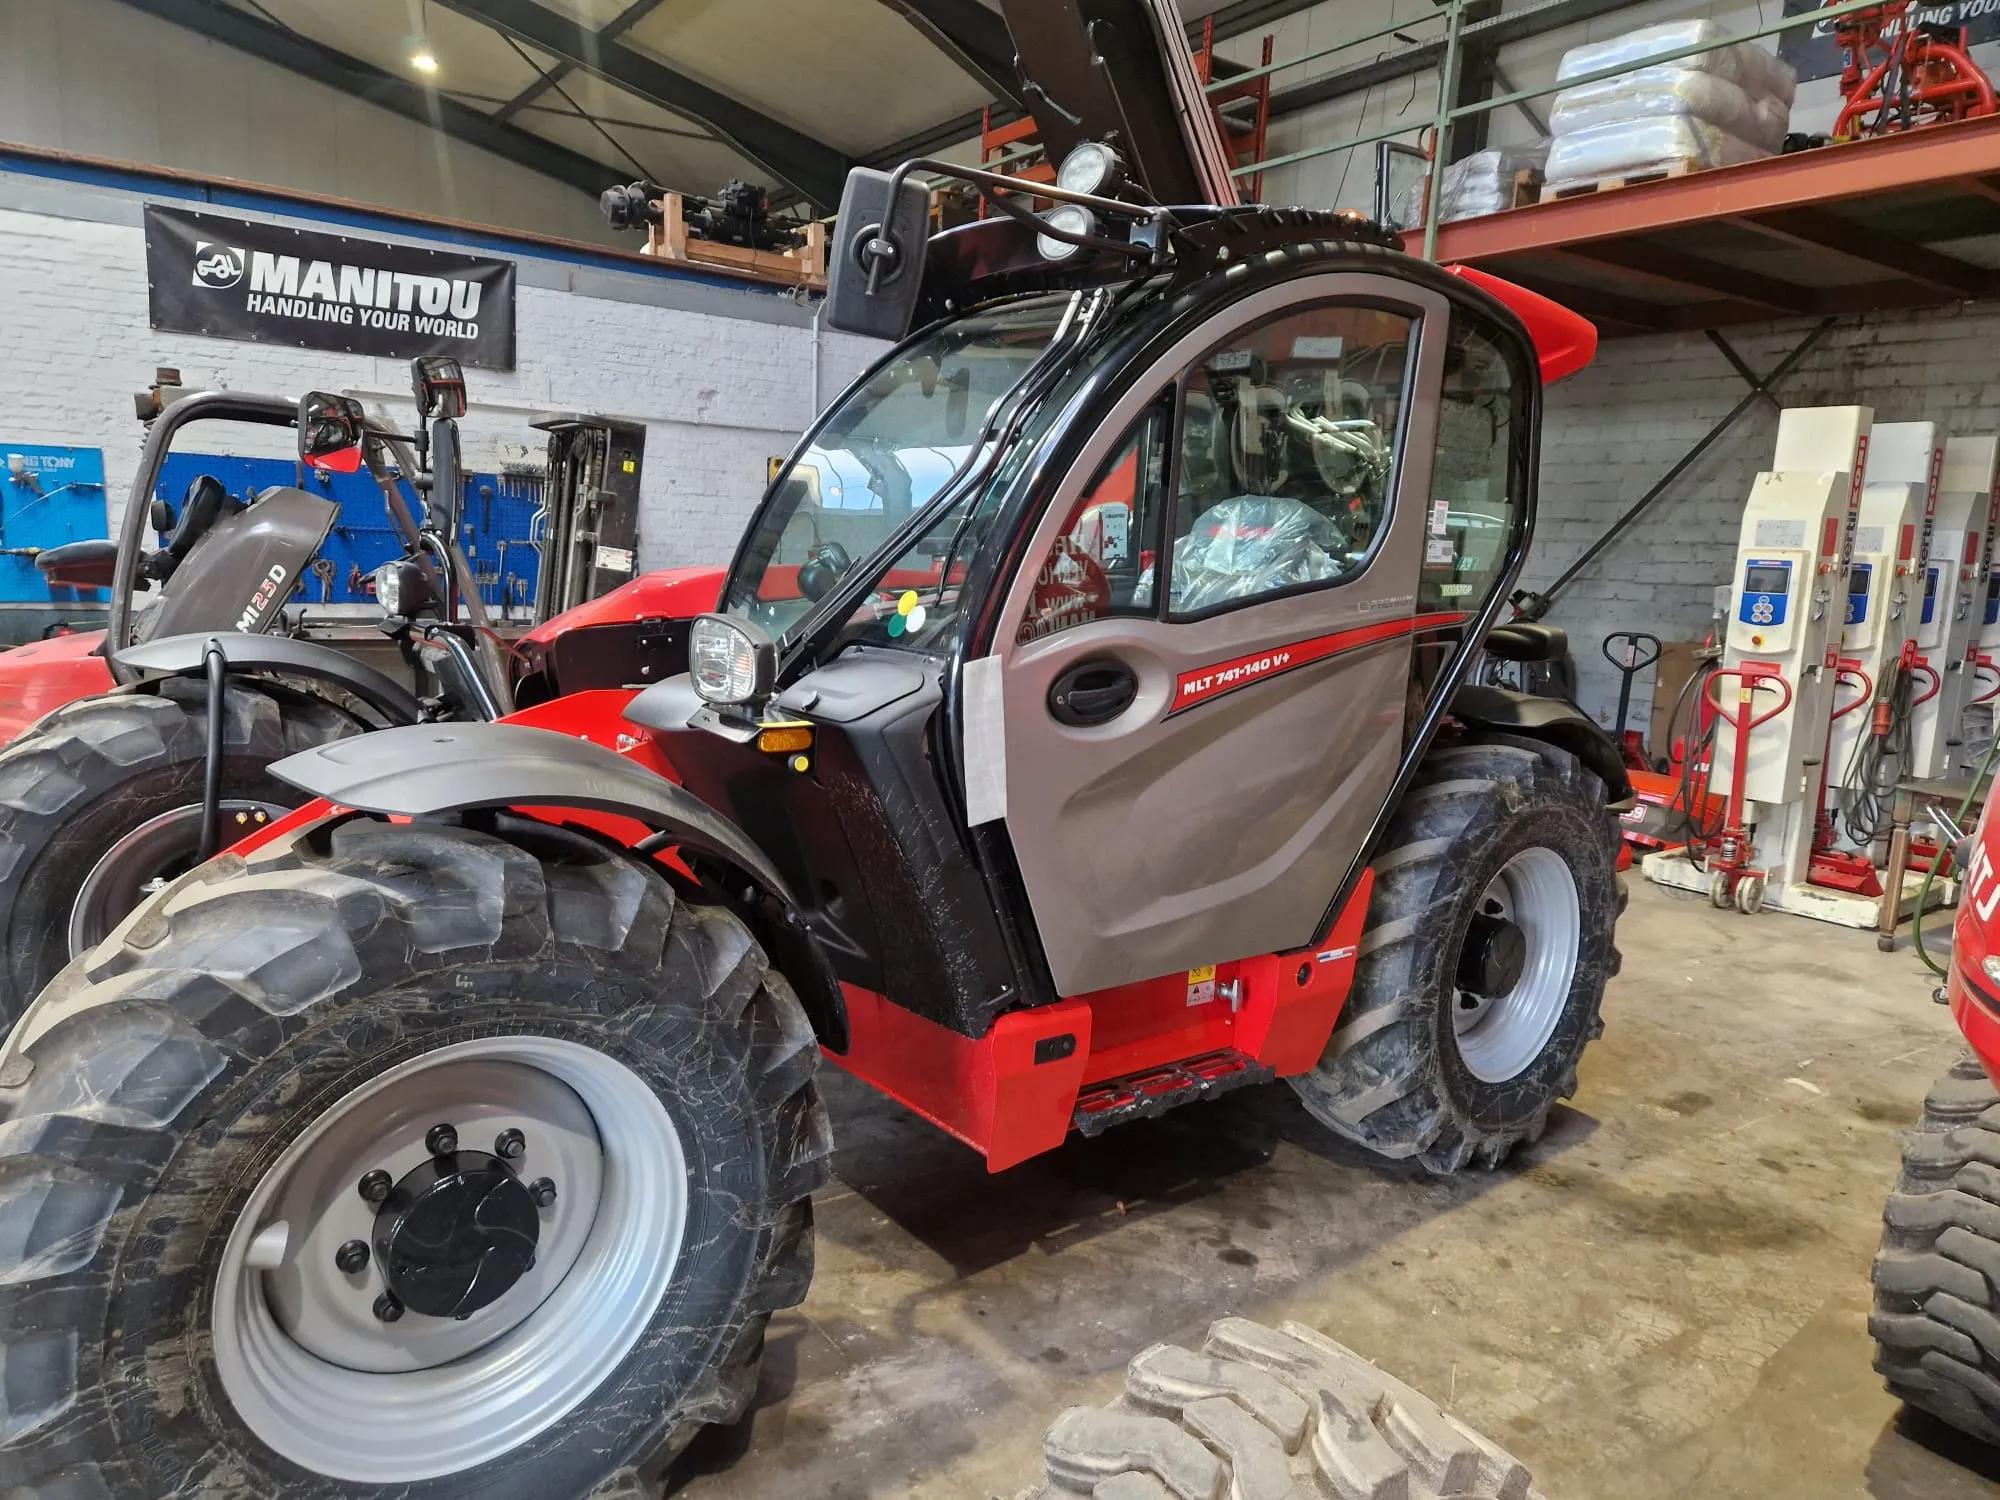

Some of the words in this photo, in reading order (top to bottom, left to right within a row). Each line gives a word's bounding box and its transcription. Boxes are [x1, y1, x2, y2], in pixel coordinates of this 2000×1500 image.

[1960, 0, 2000, 20] YOU
[249, 249, 482, 320] MANITOU
[246, 293, 353, 326] HANDLING
[359, 307, 410, 332] YOUR
[414, 316, 479, 340] WORLD
[41, 456, 75, 468] TONY
[1840, 511, 1857, 580] stertil
[1917, 518, 1934, 581] stertil
[1183, 675, 1213, 696] MLT
[1215, 658, 1271, 685] 741-140
[1273, 652, 1290, 666] V+
